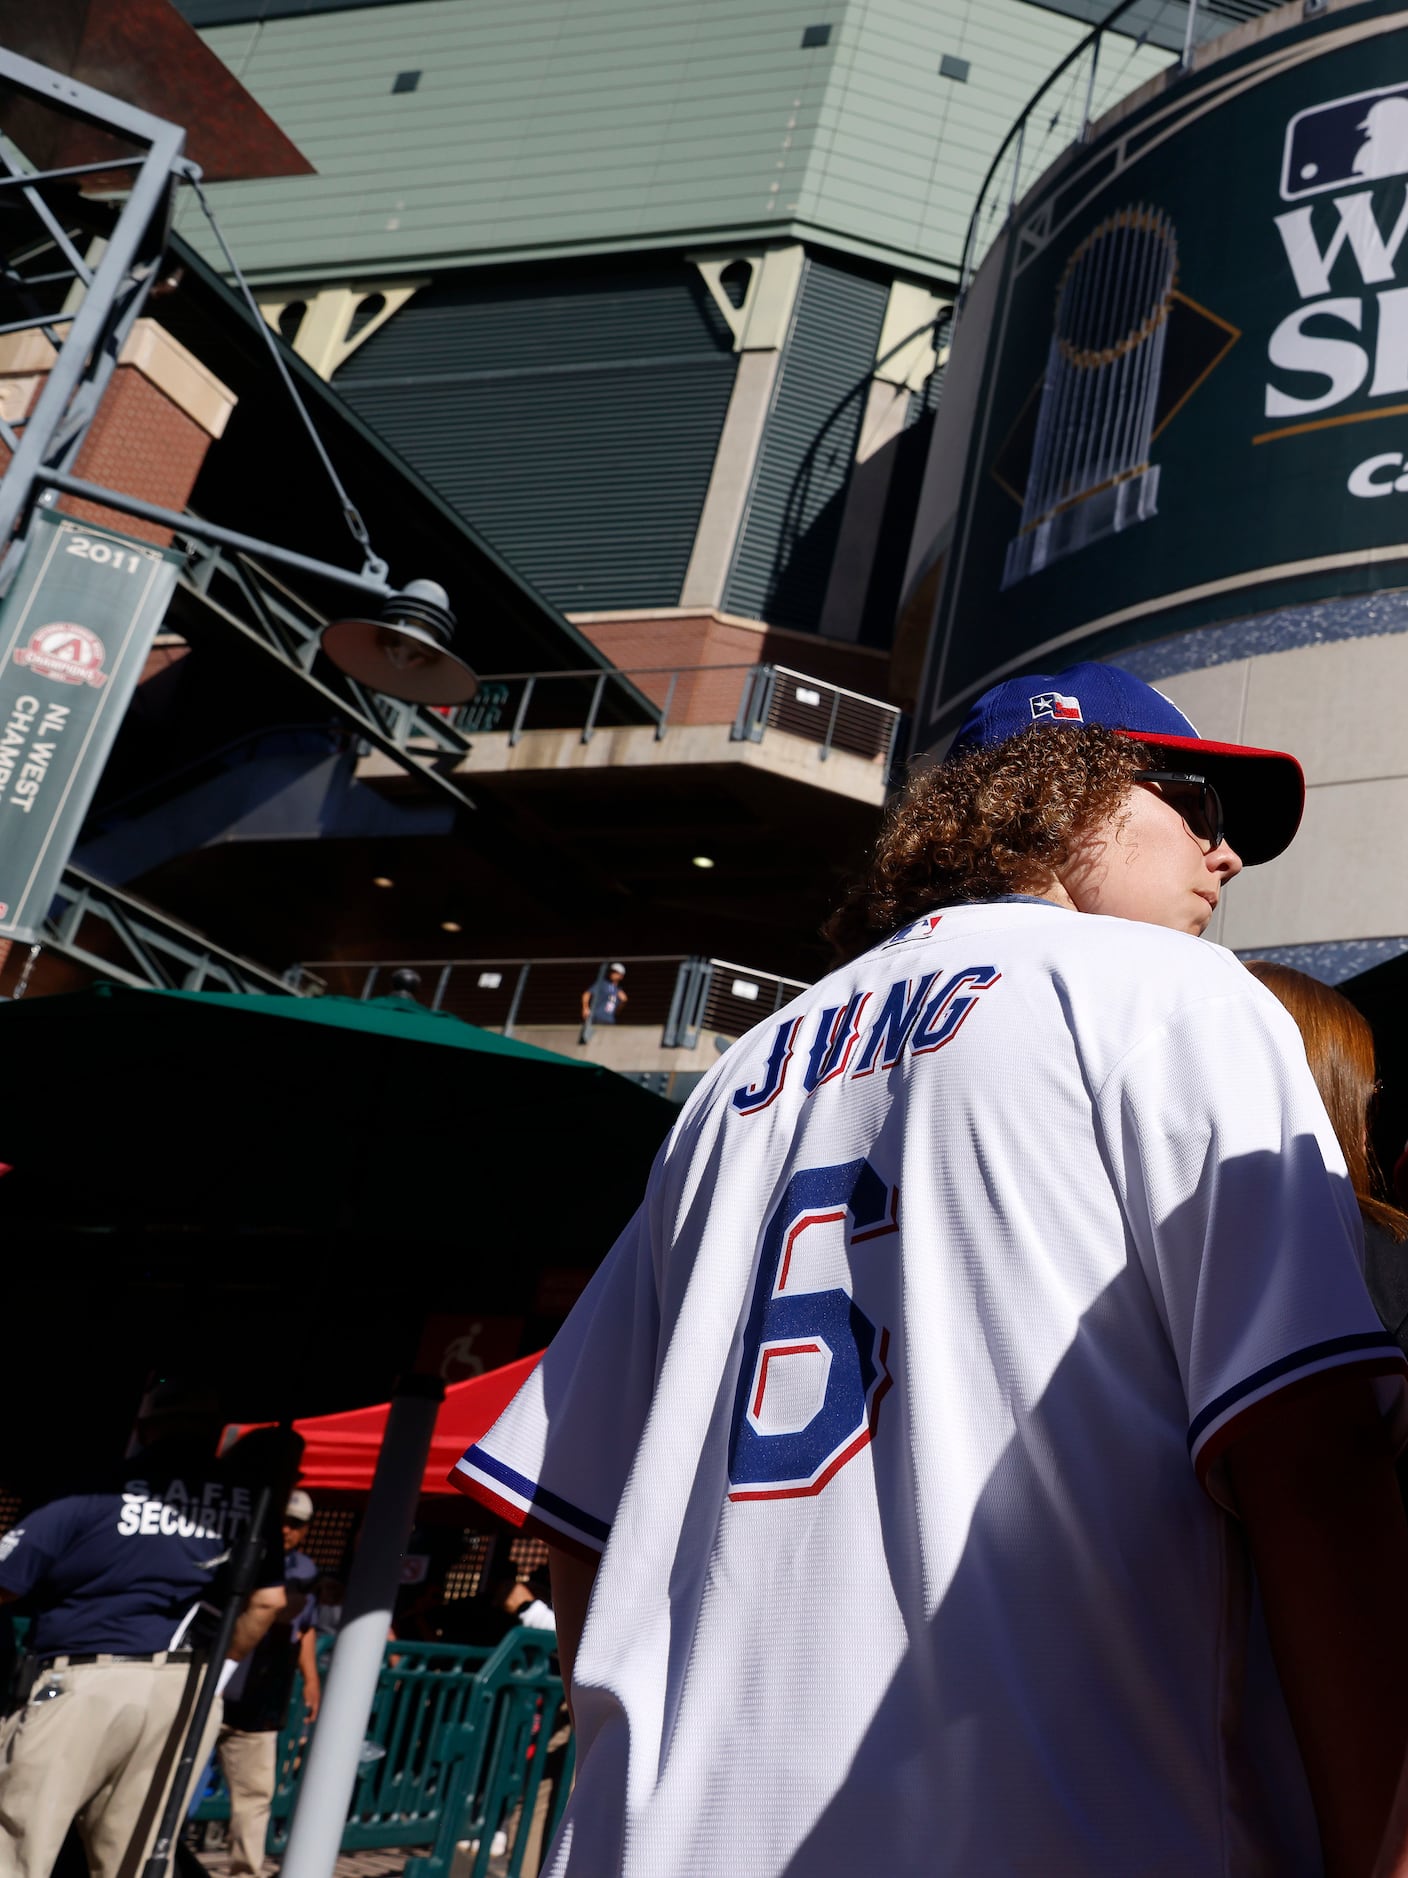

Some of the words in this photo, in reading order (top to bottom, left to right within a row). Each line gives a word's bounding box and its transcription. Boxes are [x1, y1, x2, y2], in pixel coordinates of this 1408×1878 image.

[66, 536, 142, 575] 2011
[0, 694, 40, 804] CHAMP
[37, 702, 71, 737] NL
[9, 742, 57, 814] WEST
[732, 963, 1001, 1116] JUNG
[728, 1157, 900, 1502] 6
